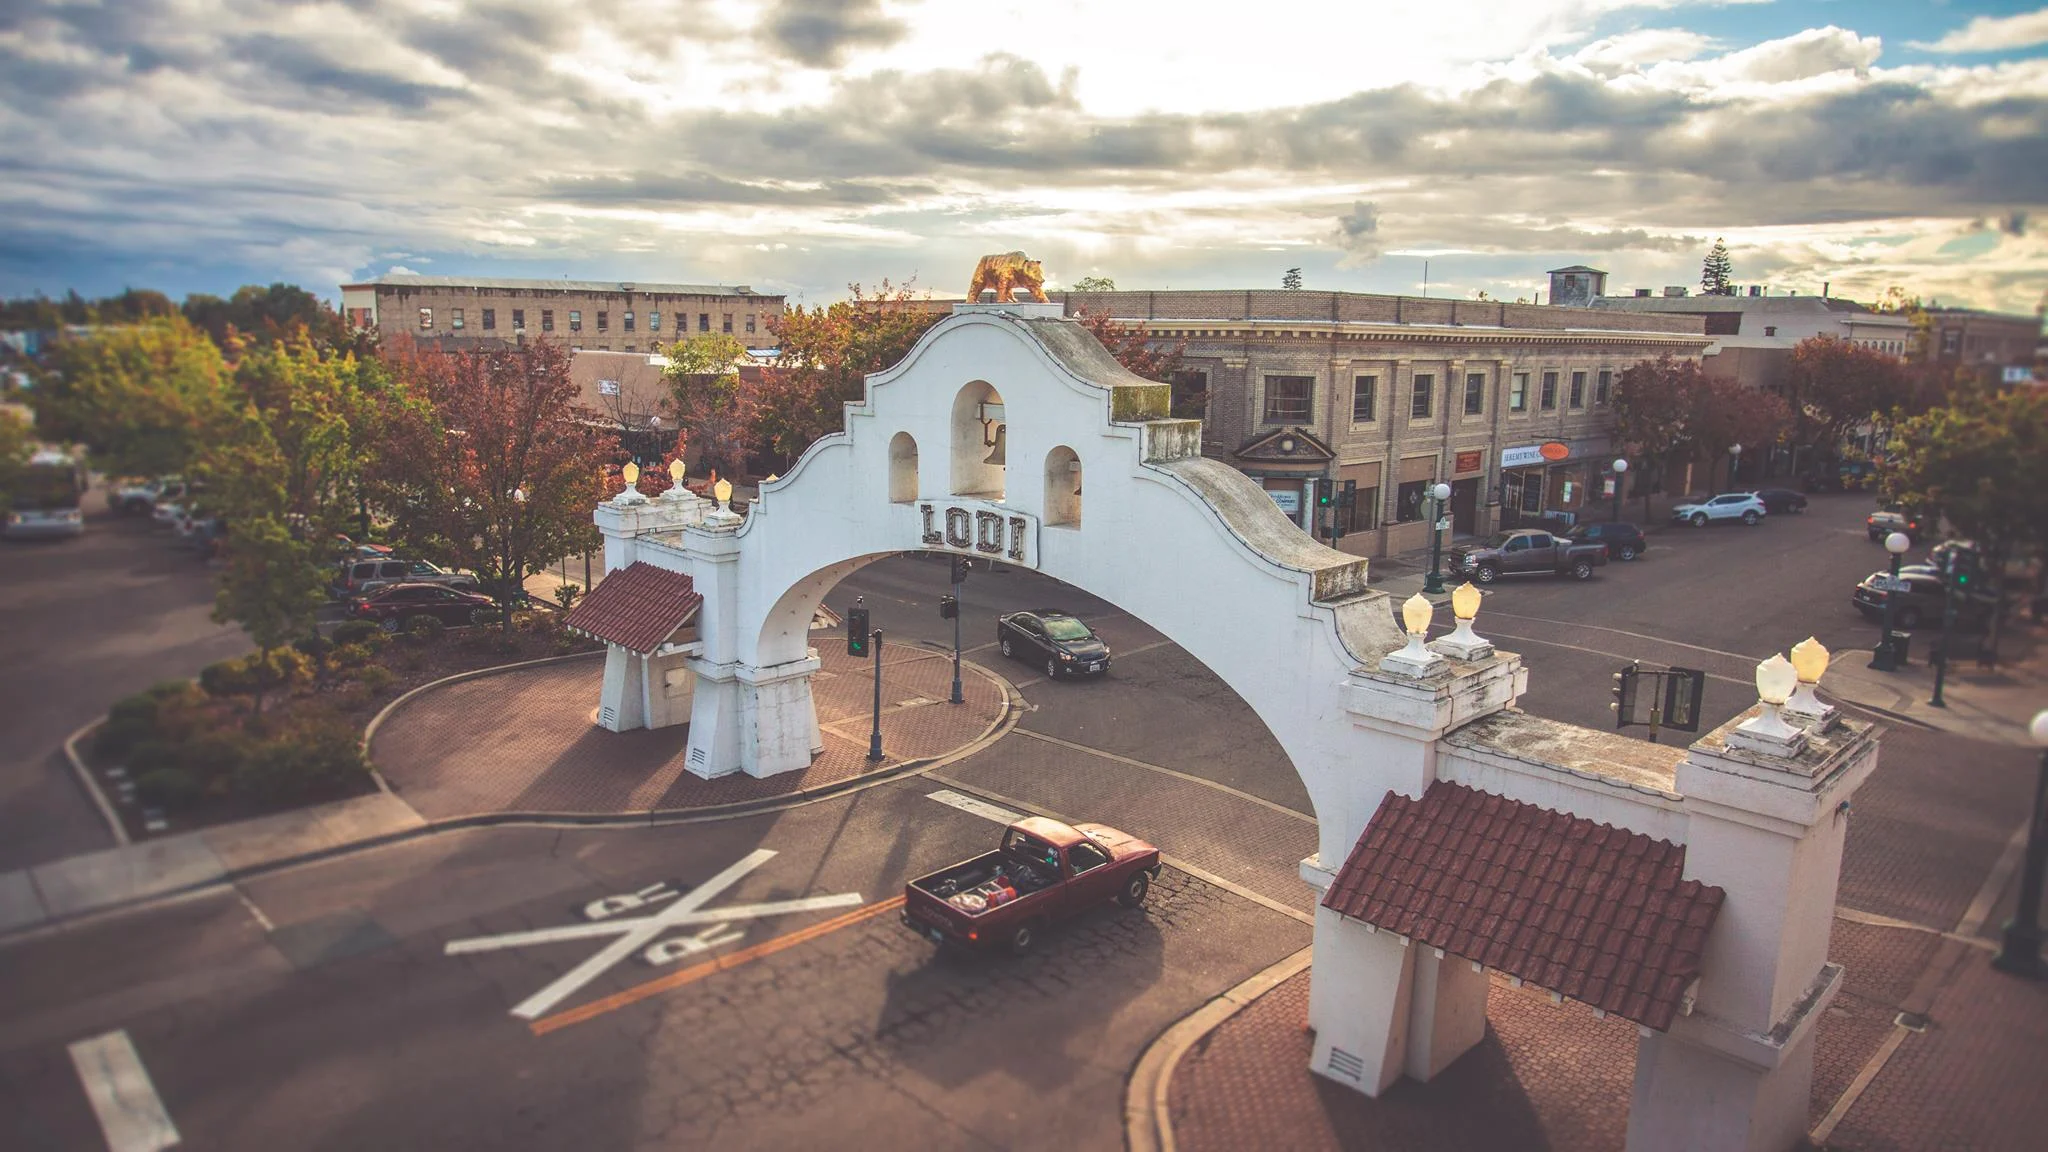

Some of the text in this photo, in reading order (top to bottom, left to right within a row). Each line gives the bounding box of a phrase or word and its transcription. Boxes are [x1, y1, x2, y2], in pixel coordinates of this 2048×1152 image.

[920, 504, 1026, 560] LODI
[583, 881, 680, 920] R
[644, 922, 746, 966] R
